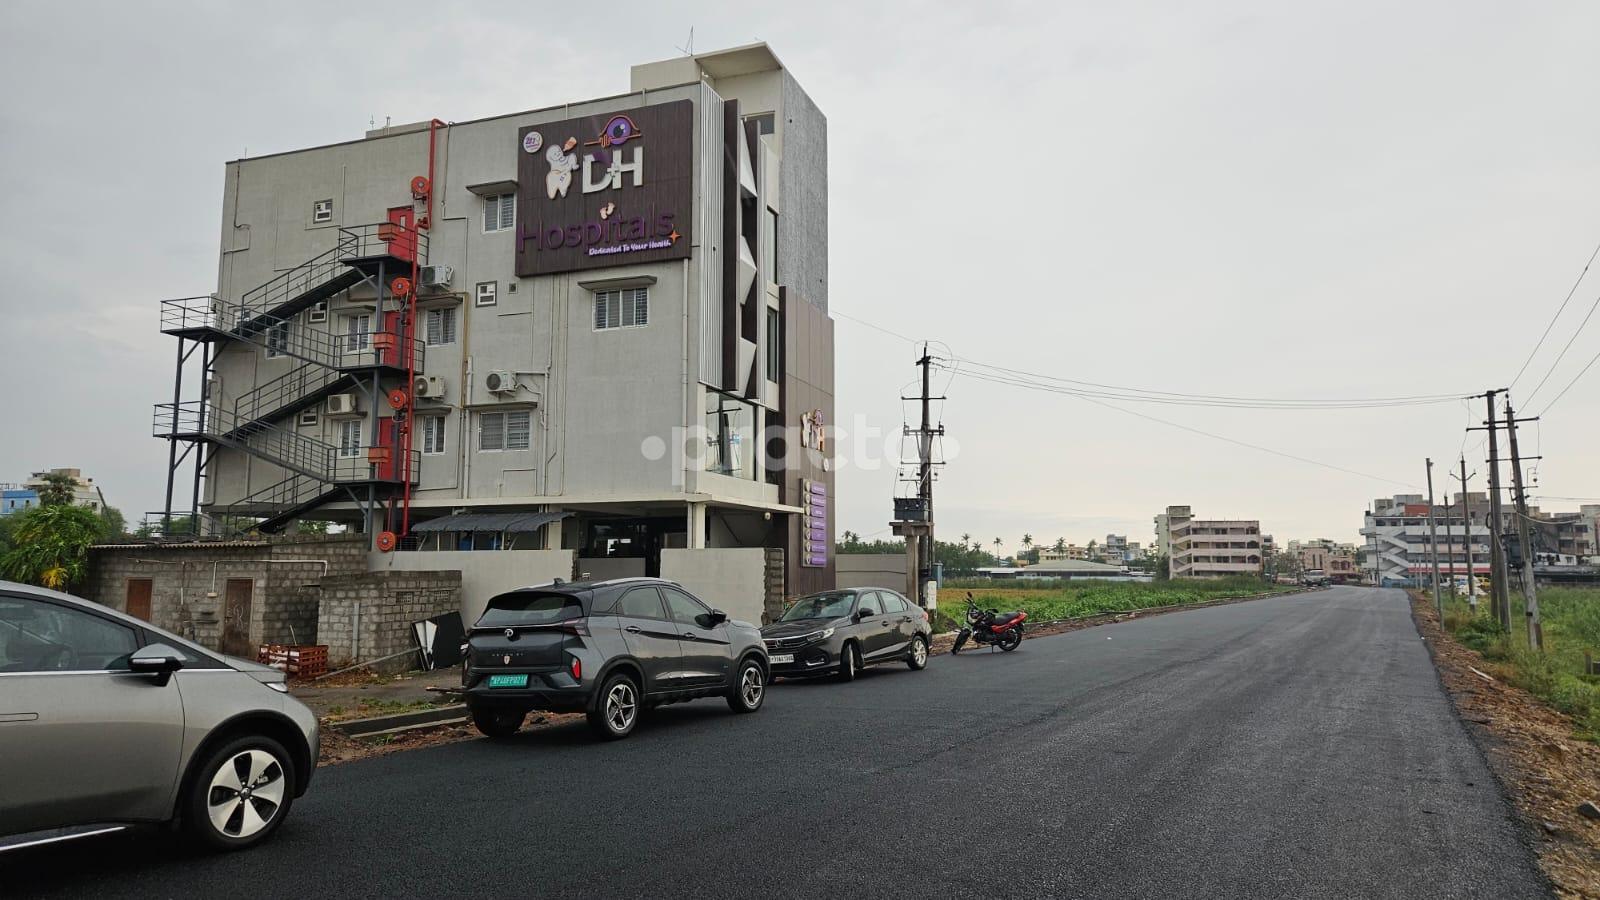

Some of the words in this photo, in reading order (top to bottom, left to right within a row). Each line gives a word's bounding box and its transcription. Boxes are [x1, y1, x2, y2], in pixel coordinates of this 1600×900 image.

[516, 202, 675, 253] Hospitals
[622, 244, 630, 252] To
[630, 242, 648, 251] Your
